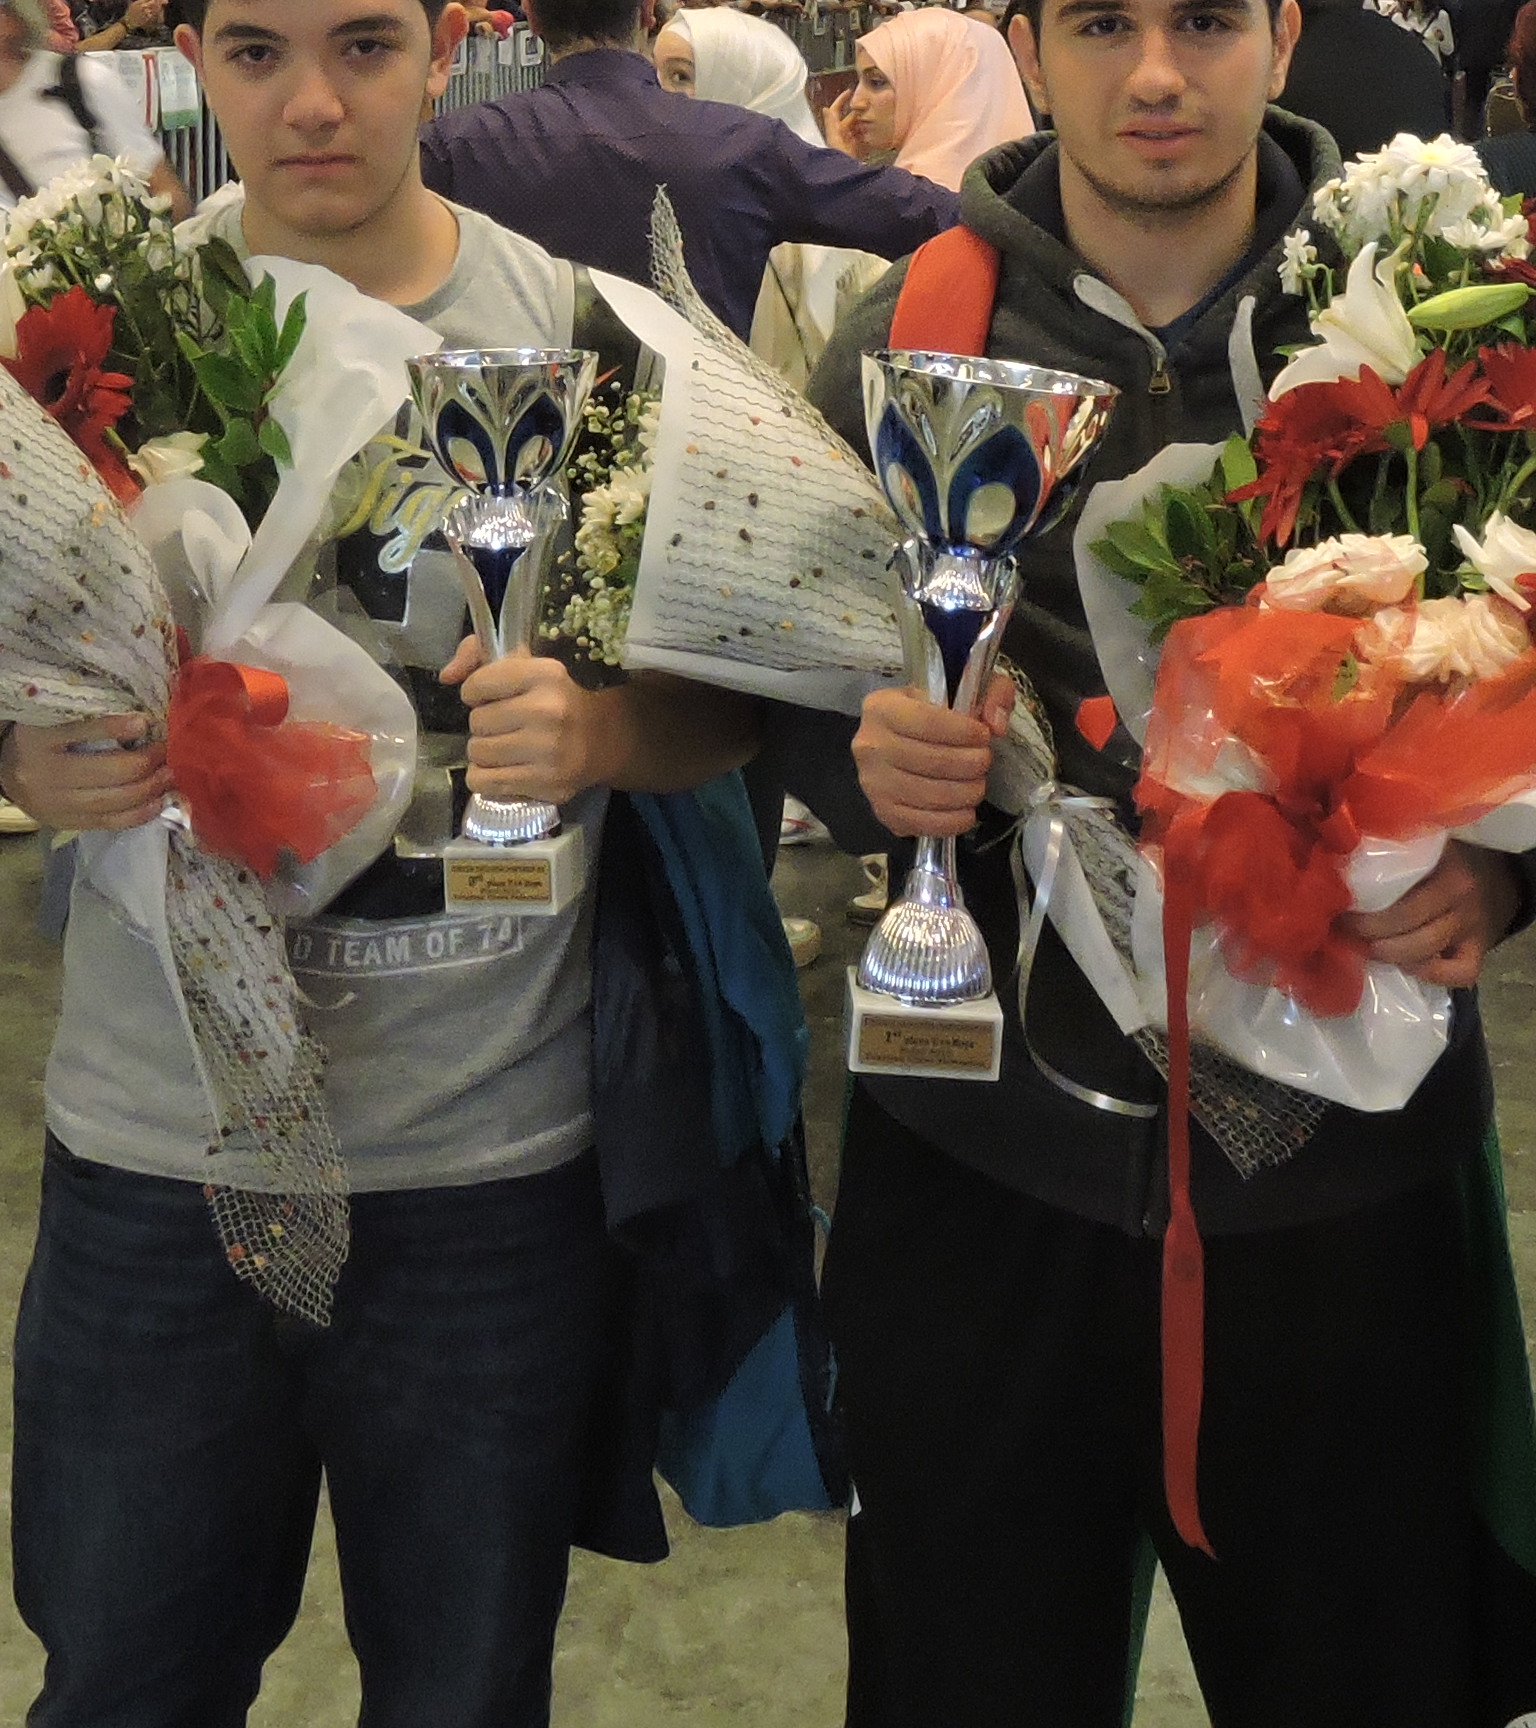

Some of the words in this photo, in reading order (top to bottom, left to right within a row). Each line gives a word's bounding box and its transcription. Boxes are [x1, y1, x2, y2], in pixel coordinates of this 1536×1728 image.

[327, 934, 411, 968] TEAM
[425, 928, 465, 959] OF
[477, 916, 513, 950] 74
